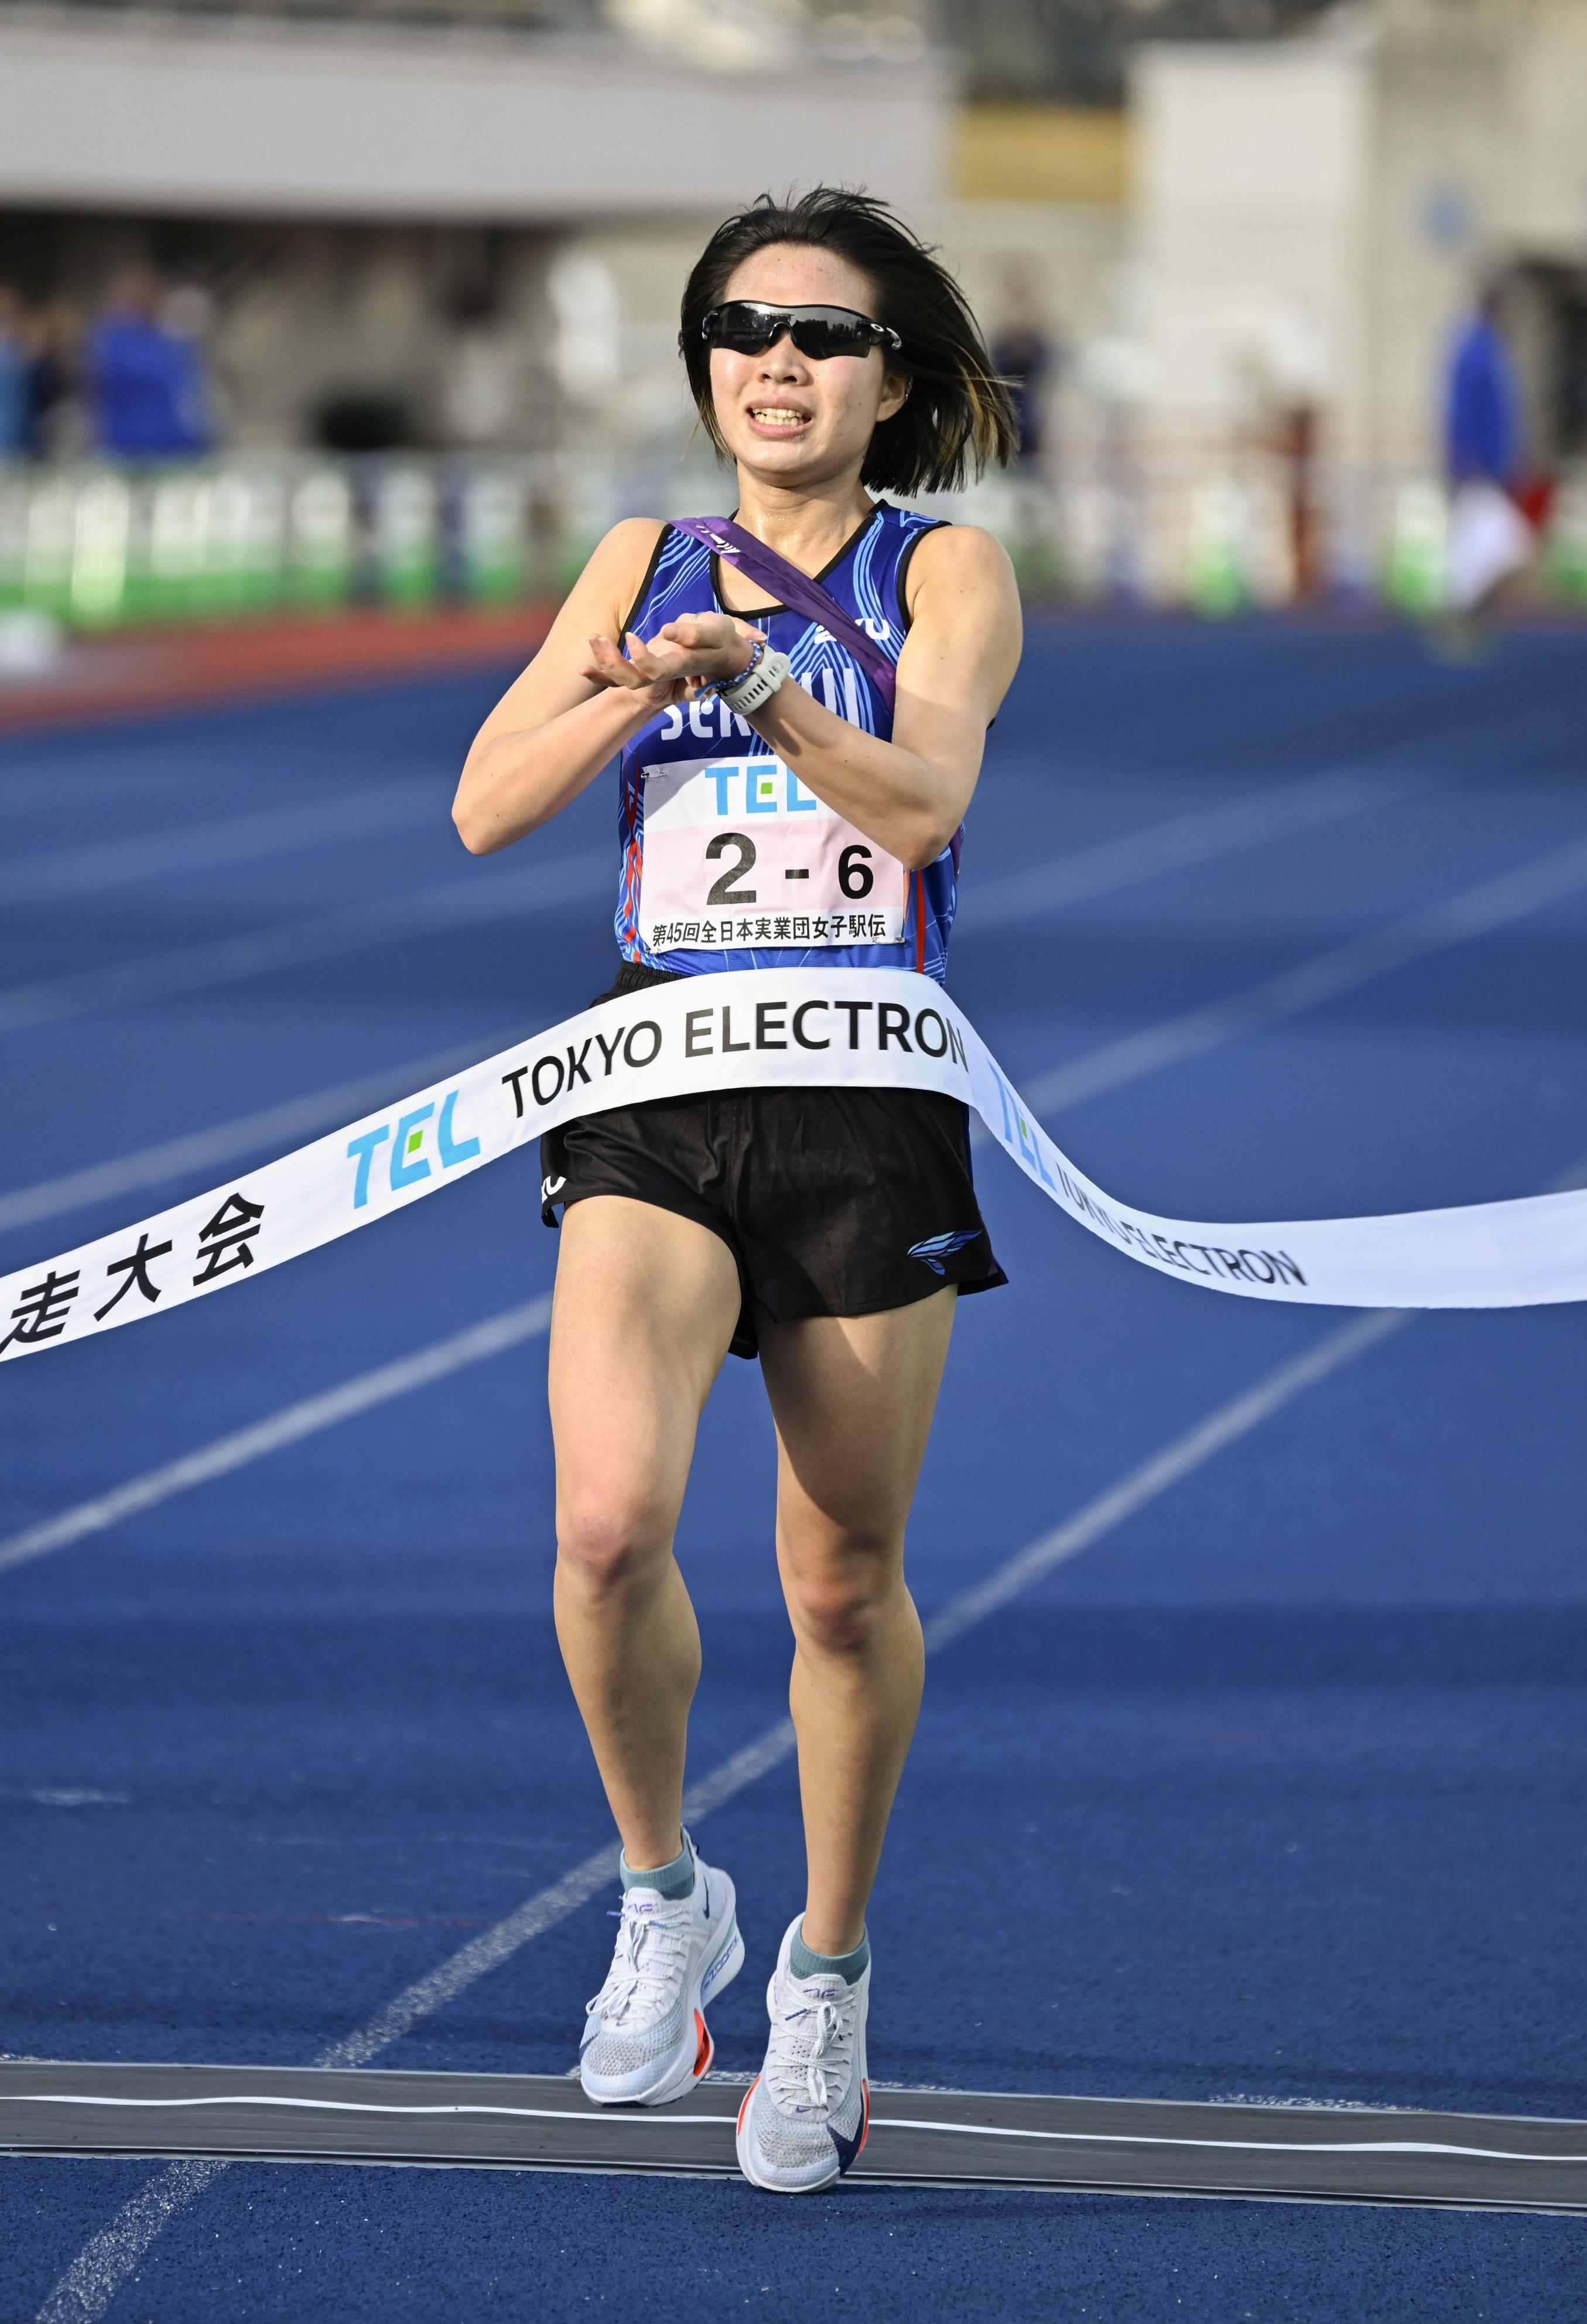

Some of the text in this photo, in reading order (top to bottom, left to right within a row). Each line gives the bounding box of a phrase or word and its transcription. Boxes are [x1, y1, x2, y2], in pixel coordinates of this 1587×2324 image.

[704, 764, 816, 816] TEL
[652, 913, 886, 946] 第45回全日本実業団女子駅伝
[347, 1000, 969, 1209] TEL TOKYO ELECTRON
[1120, 1220, 1309, 1287] ELECTRON
